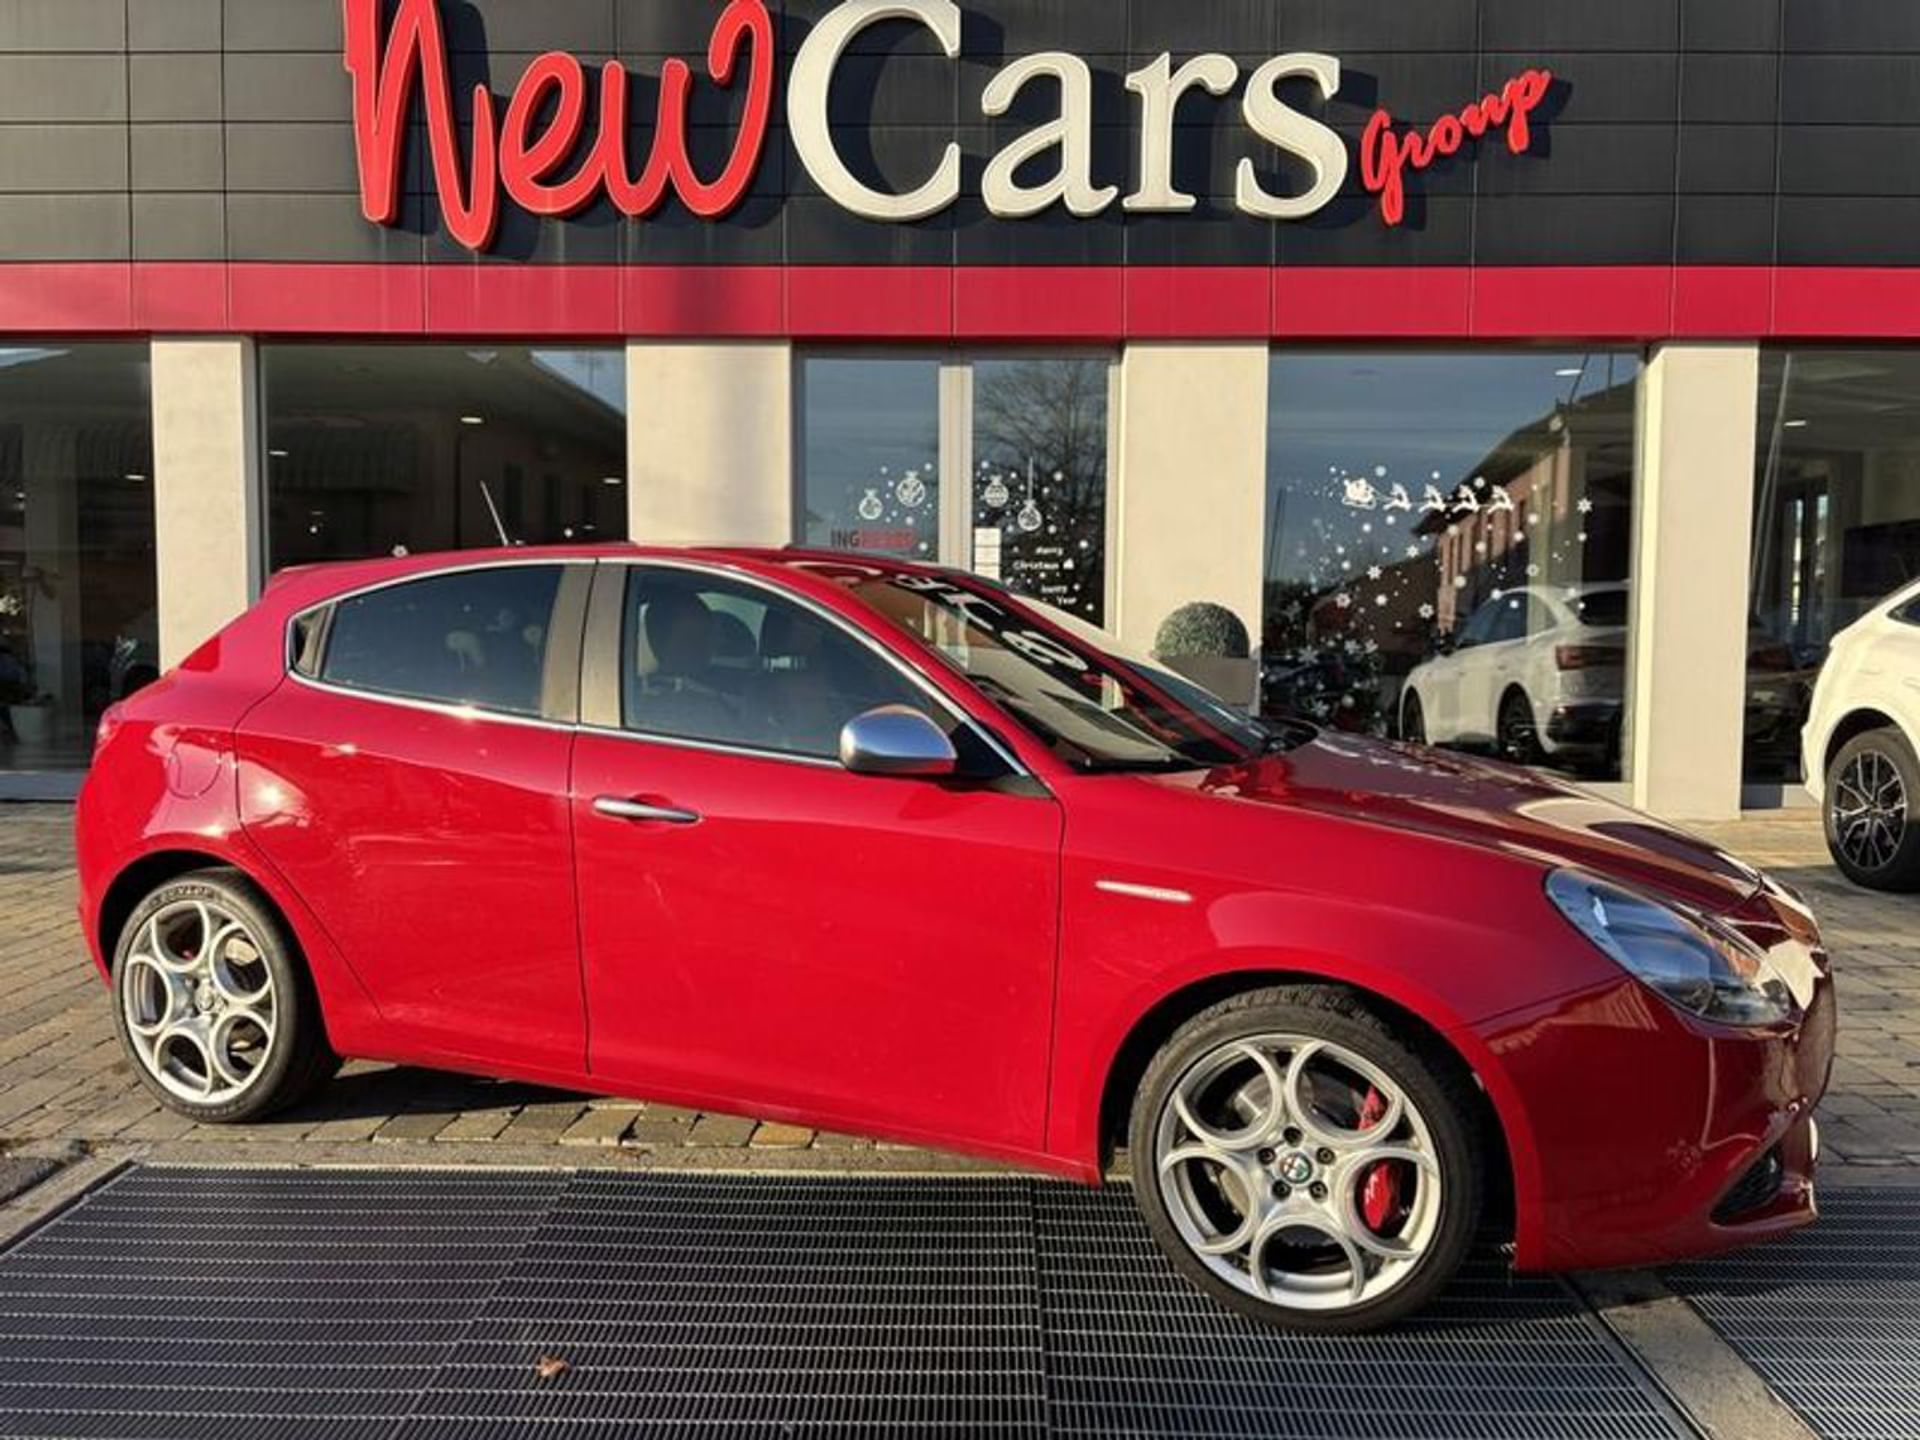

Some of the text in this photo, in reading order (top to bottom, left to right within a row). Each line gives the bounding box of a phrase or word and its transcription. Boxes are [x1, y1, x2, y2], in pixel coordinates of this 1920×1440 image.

[344, 0, 1553, 251] New Cars Group
